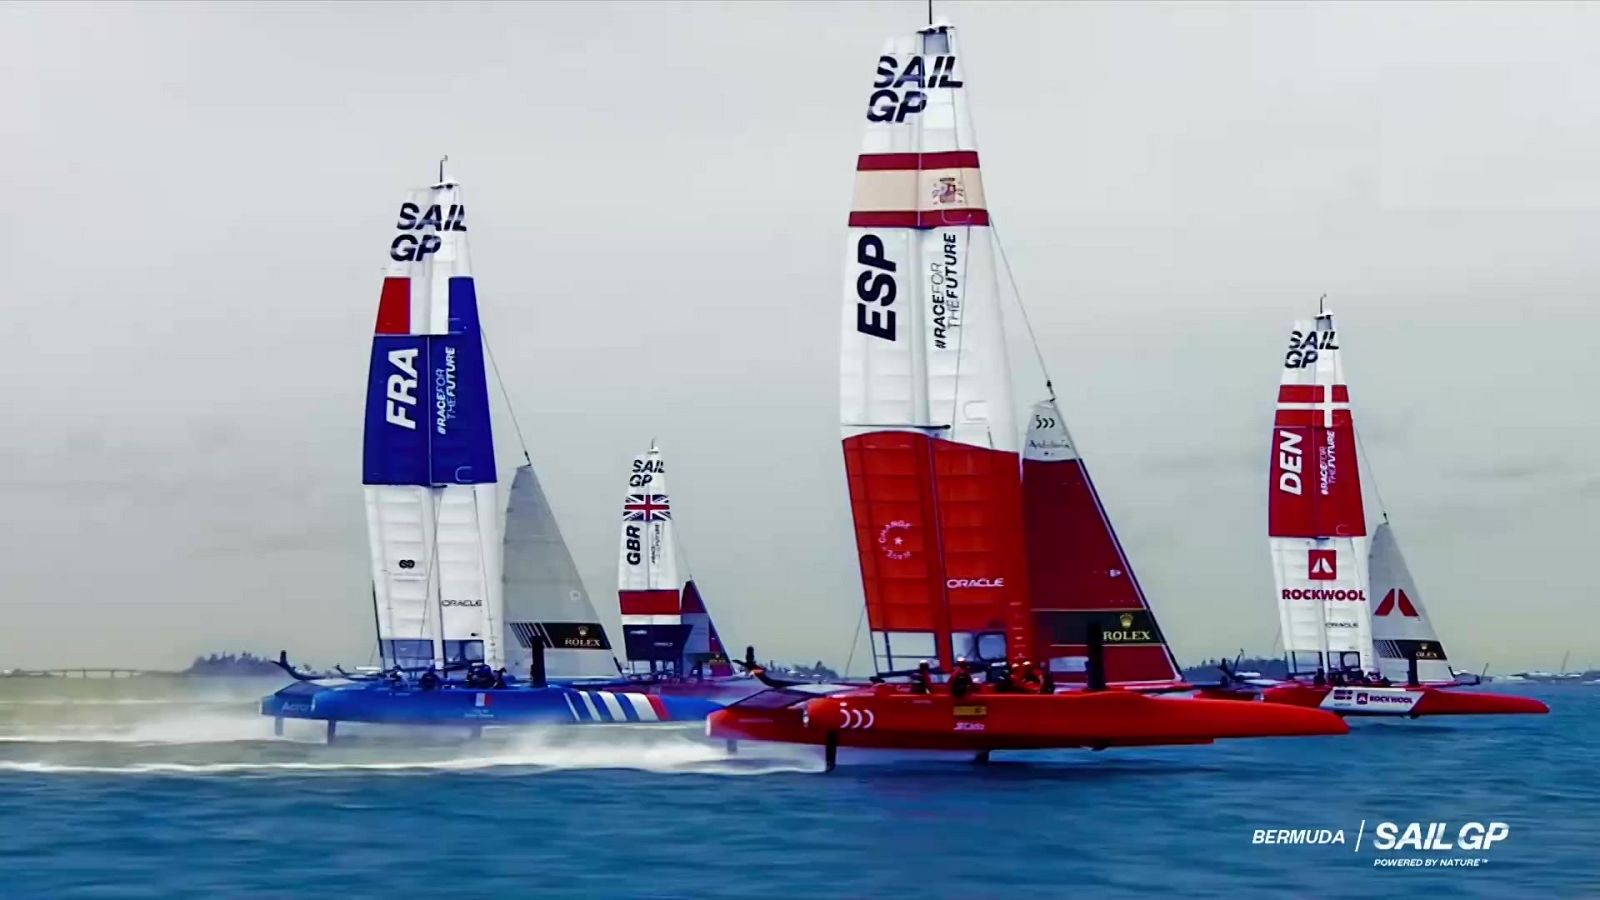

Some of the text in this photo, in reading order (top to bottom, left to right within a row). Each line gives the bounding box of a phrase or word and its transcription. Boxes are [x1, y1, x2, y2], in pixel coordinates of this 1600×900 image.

[873, 56, 964, 88] SAIL
[866, 89, 928, 123] GP
[396, 202, 467, 231] SAIL
[390, 234, 442, 262] GP
[857, 234, 897, 342] ESP
[1288, 330, 1340, 350] SAIL
[1284, 350, 1319, 369] GP
[385, 348, 419, 430] FRA
[632, 459, 665, 473] SAIL
[1279, 429, 1303, 496] DEN
[629, 474, 653, 487] GP
[626, 525, 641, 566] GBR
[946, 577, 1005, 589] ORACLE
[1281, 588, 1366, 601] ROCKWOOL
[564, 639, 601, 647] ROLEX
[1103, 631, 1151, 641] ROLEX
[1415, 650, 1438, 658] OLEX
